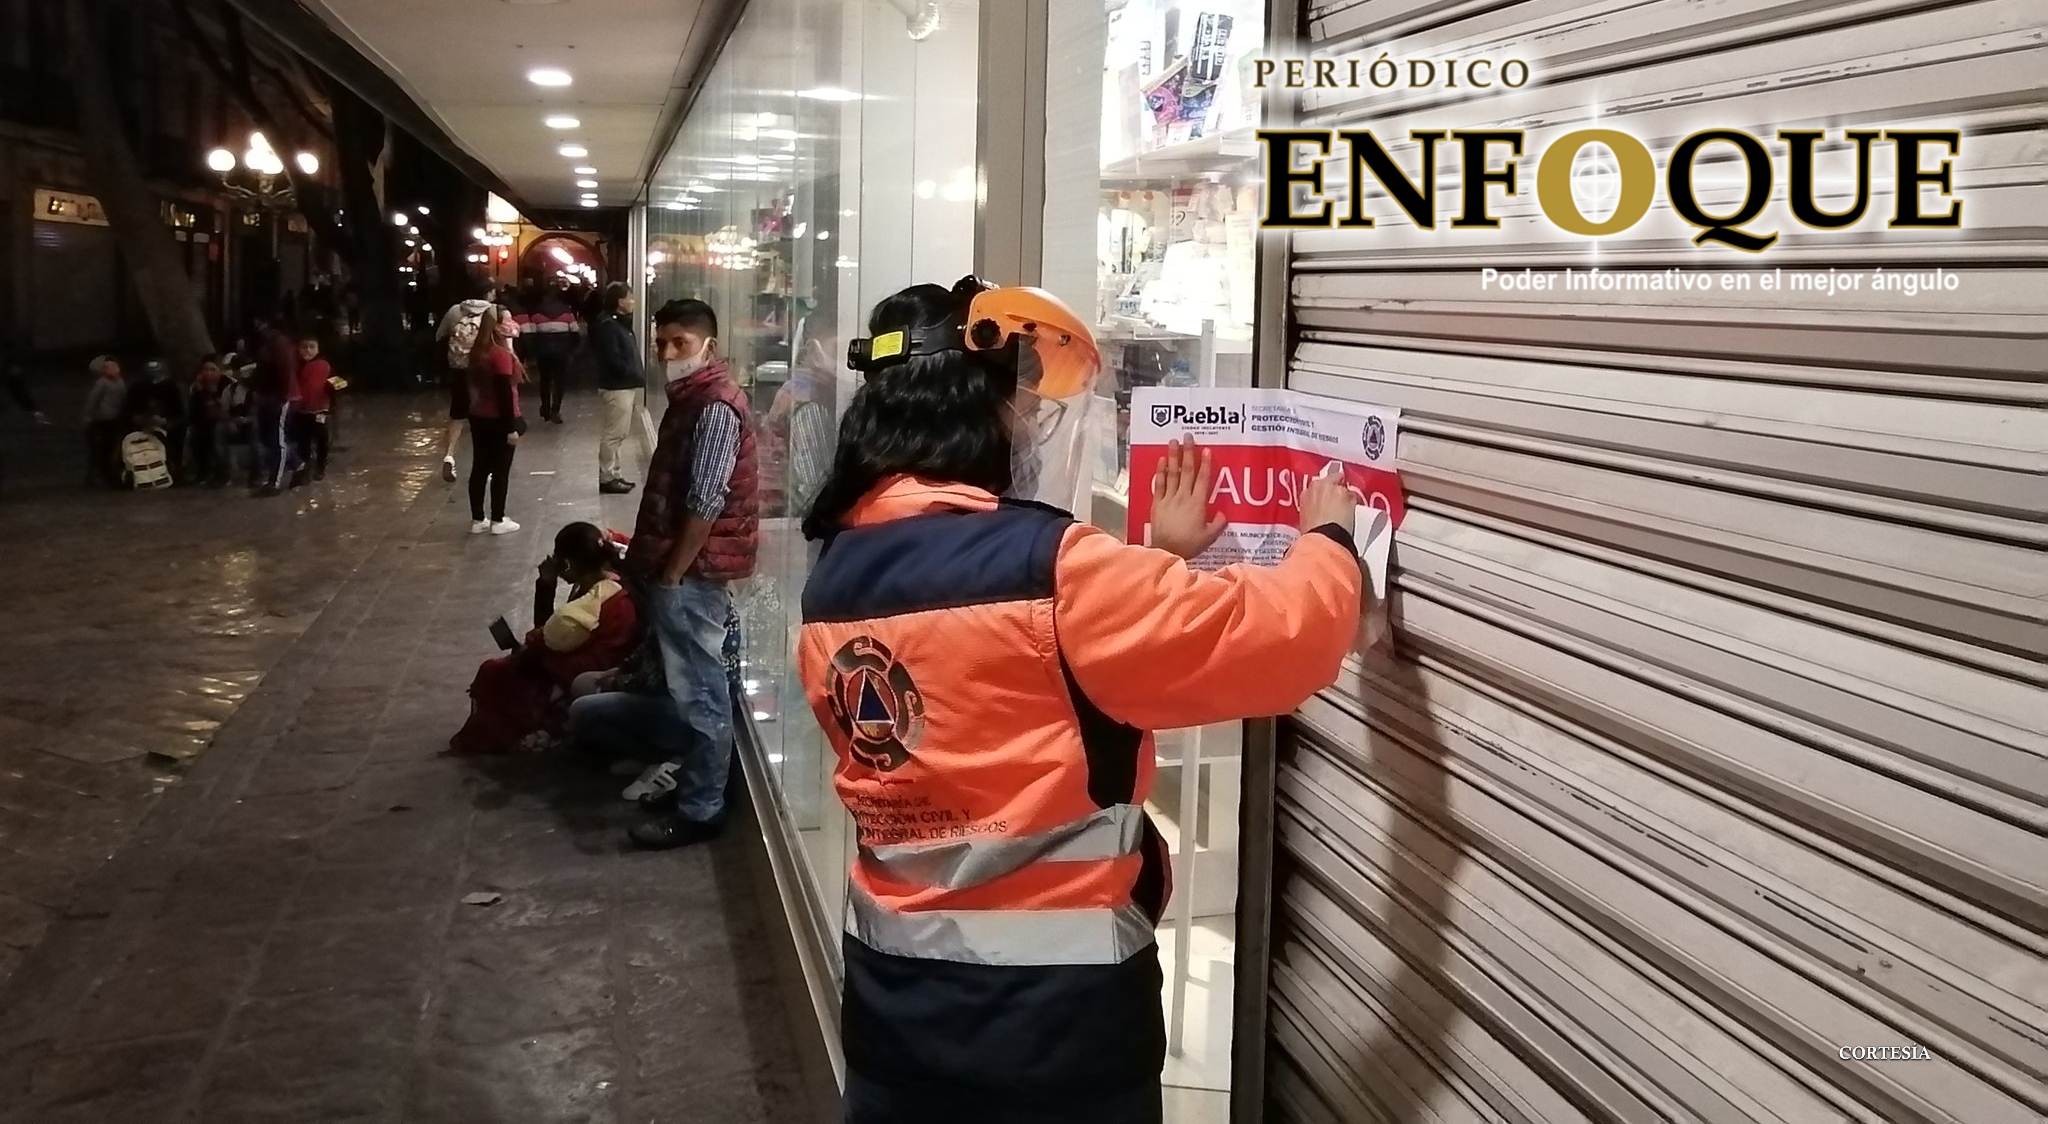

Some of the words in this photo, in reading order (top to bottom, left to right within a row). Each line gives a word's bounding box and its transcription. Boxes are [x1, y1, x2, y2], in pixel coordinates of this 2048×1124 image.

[1173, 405, 1239, 424] Puebla
[920, 810, 958, 824] CIVIL
[962, 808, 971, 821] Y
[930, 827, 947, 839] DE
[950, 820, 1008, 838] RIESGOS
